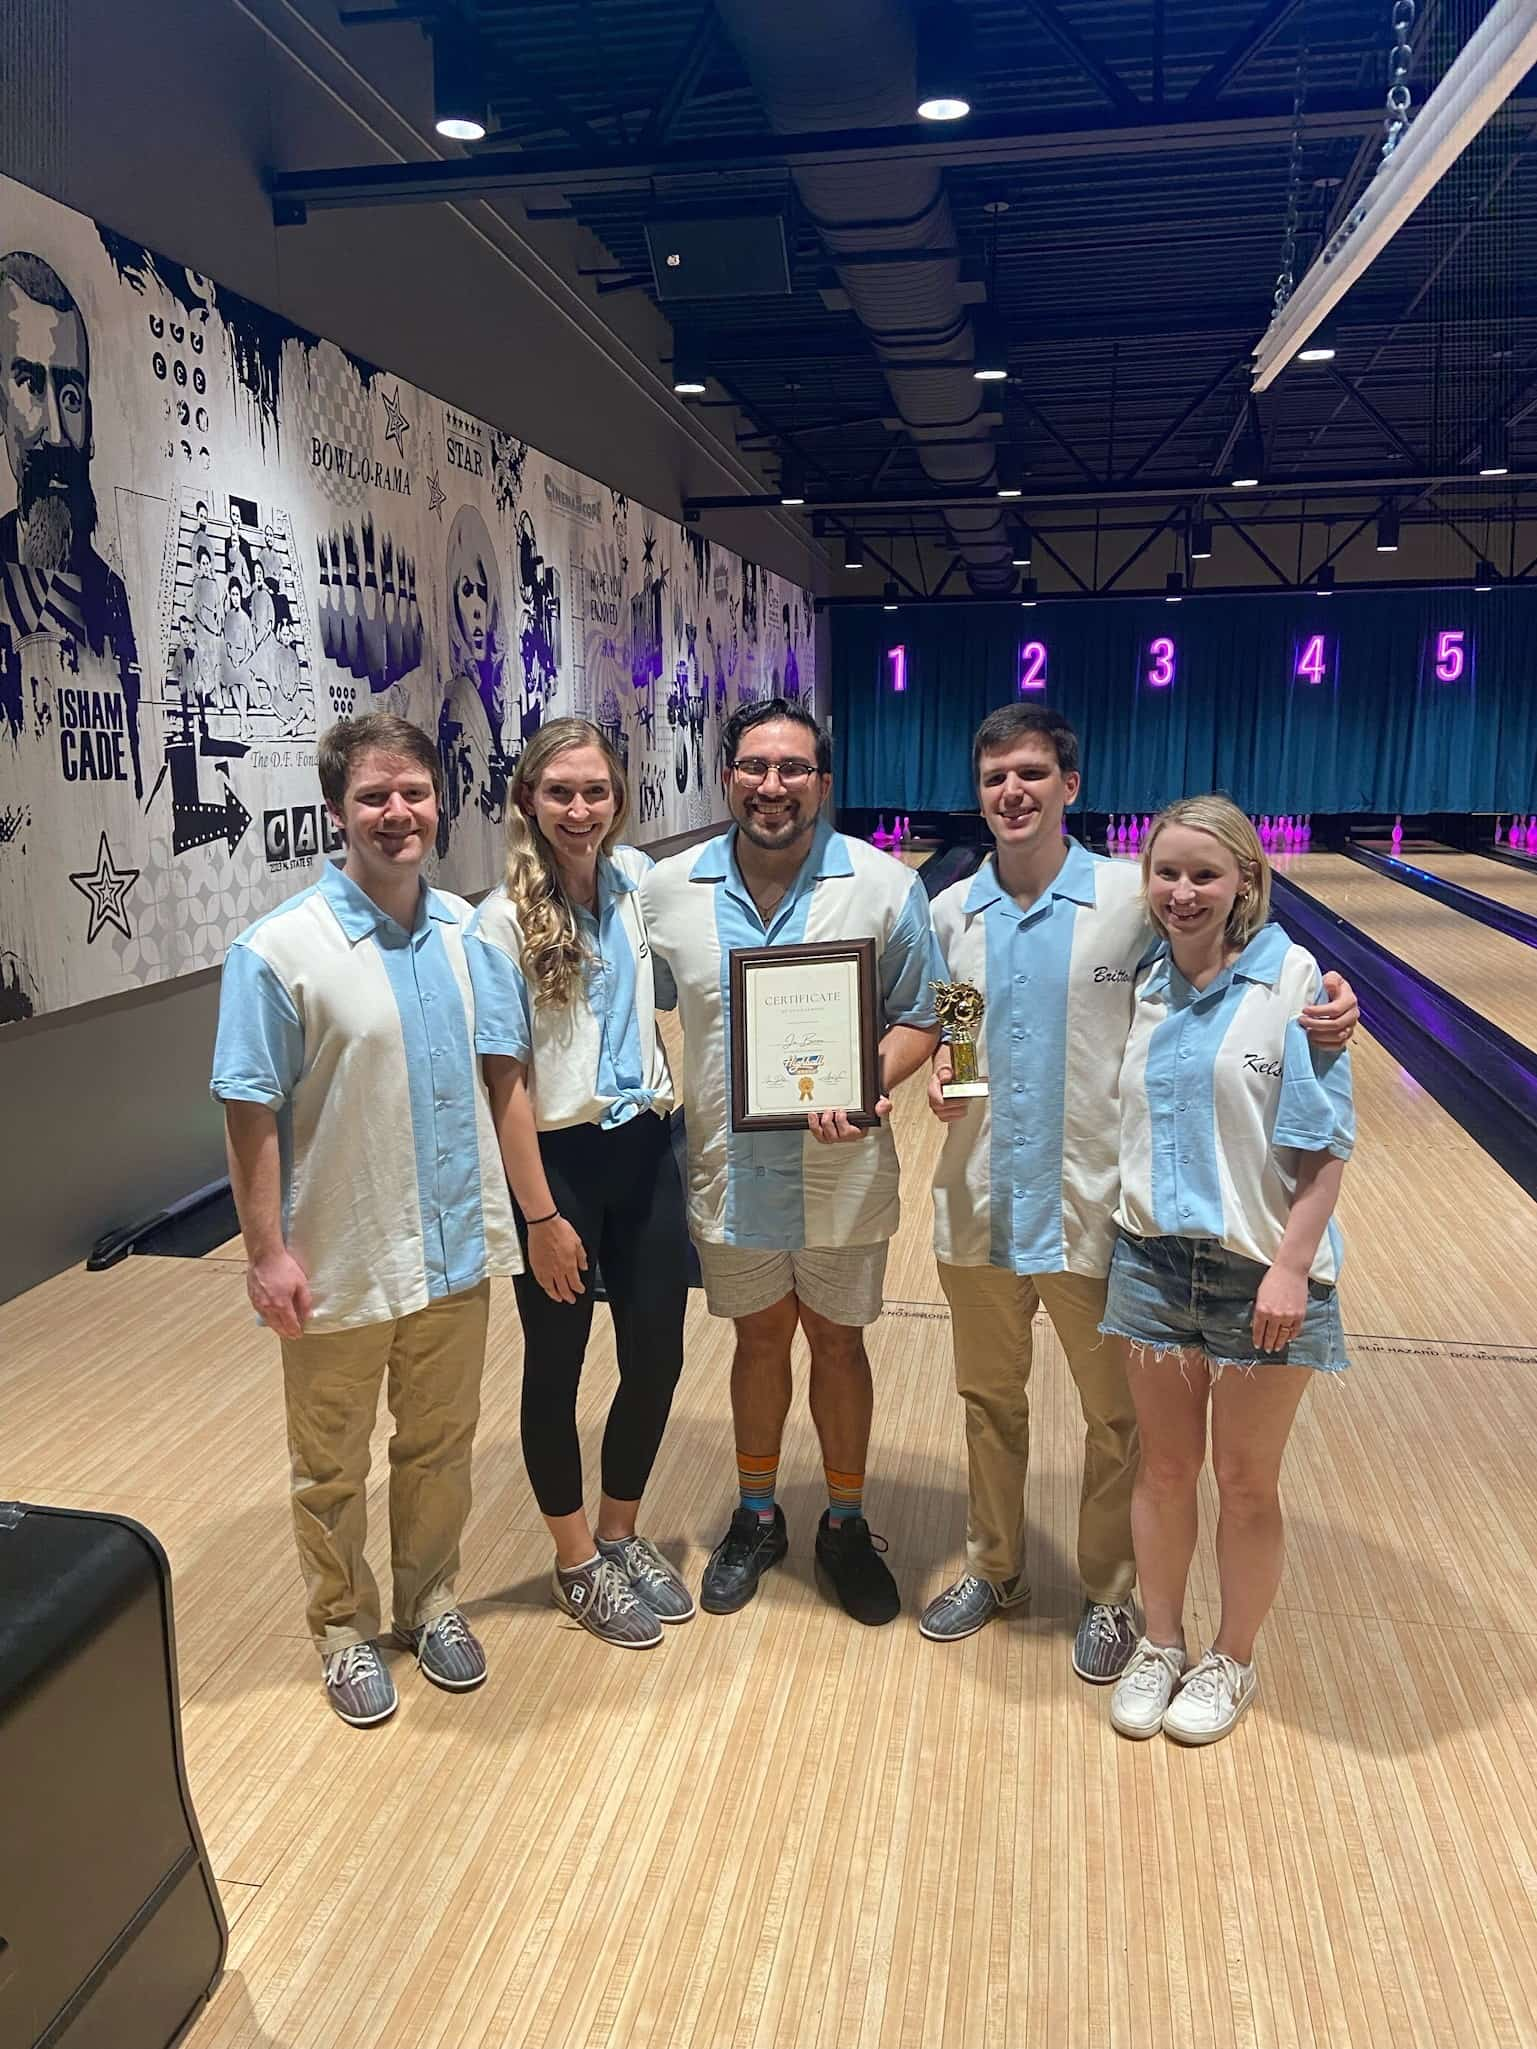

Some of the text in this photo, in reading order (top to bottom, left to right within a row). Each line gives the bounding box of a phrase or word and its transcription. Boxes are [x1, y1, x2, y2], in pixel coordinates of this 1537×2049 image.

[446, 437, 484, 478] STAR
[887, 644, 905, 691] 1
[1021, 641, 1047, 689] 2
[1148, 637, 1175, 687] 3
[1297, 634, 1326, 684] 4
[1436, 631, 1464, 682] 5
[57, 687, 124, 731] ISHAM
[60, 729, 128, 782] CADE
[252, 751, 268, 769] The
[290, 857, 306, 869] STATE
[764, 991, 841, 1007] CERTIFICATE
